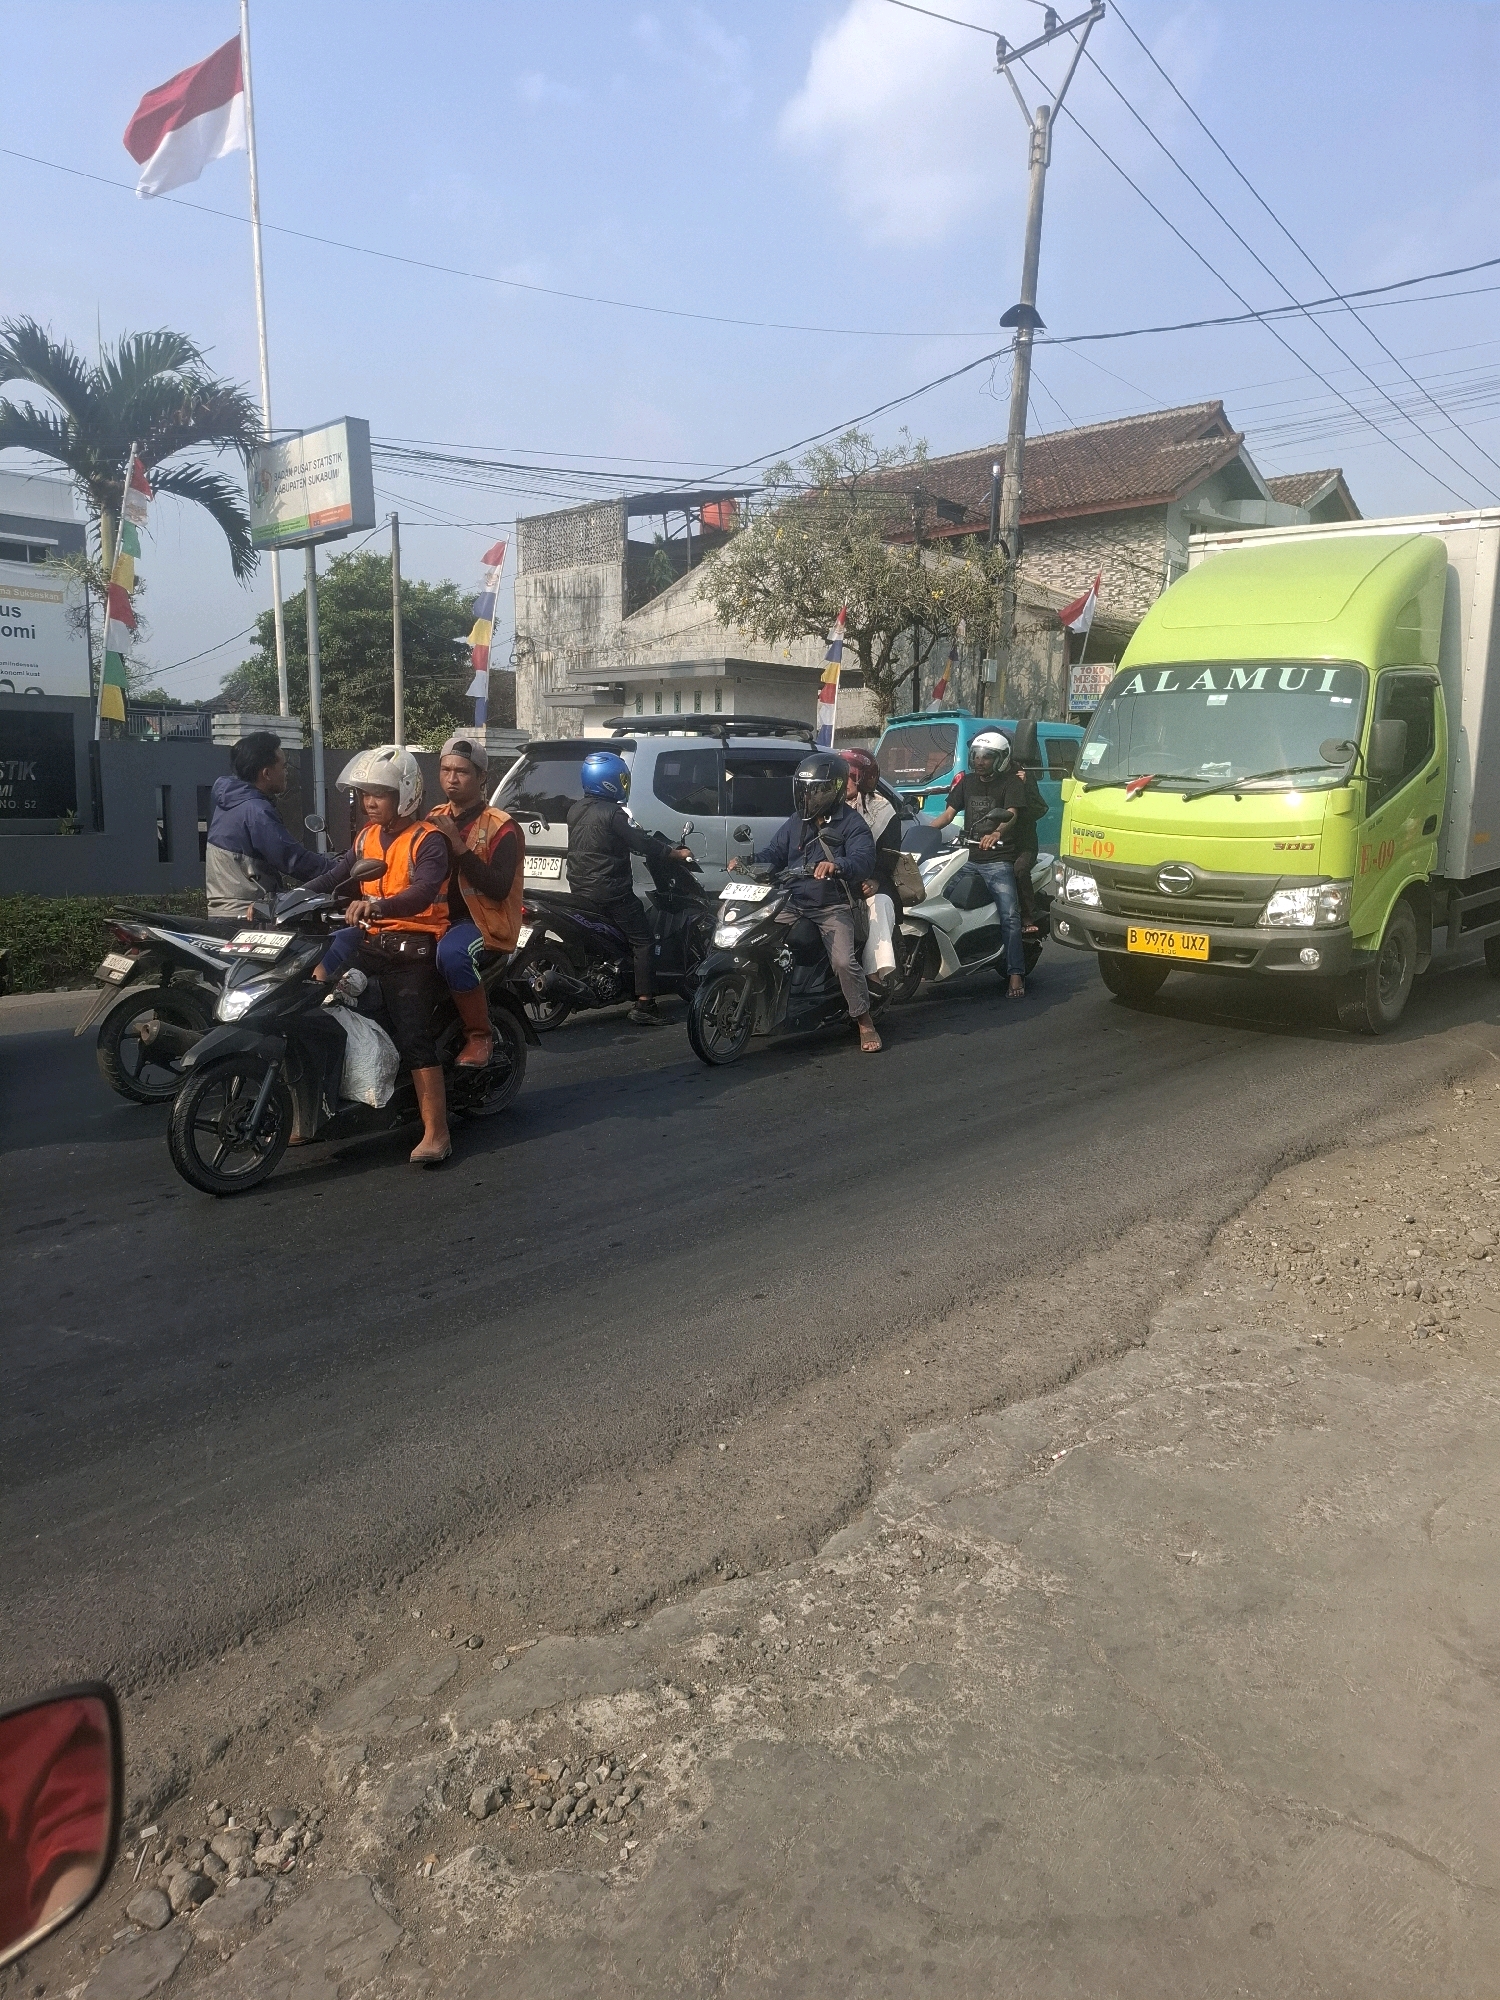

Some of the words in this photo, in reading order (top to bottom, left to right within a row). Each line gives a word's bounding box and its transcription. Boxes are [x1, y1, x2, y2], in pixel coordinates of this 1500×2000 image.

[294, 461, 312, 476] PUSAT
[313, 451, 343, 470] STATISTIK
[274, 477, 307, 496] KABUPATEN
[308, 468, 340, 486] SUKABUMI
[14, 589, 59, 601] Sukseskan
[1, 624, 36, 640] omi
[1080, 666, 1105, 675] TOKO
[1073, 674, 1111, 684] MESIN
[1120, 667, 1340, 696] ALAMUI
[24, 800, 37, 809] 52
[1073, 827, 1105, 839] HINO
[1073, 836, 1115, 859] E-09
[1273, 842, 1315, 851] 300
[529, 857, 547, 870] 1570
[550, 858, 560, 871] ZS
[1360, 840, 1395, 875] E-09
[1130, 929, 1138, 944] B
[1144, 931, 1175, 948] 9976
[1182, 934, 1206, 951] UXZ
